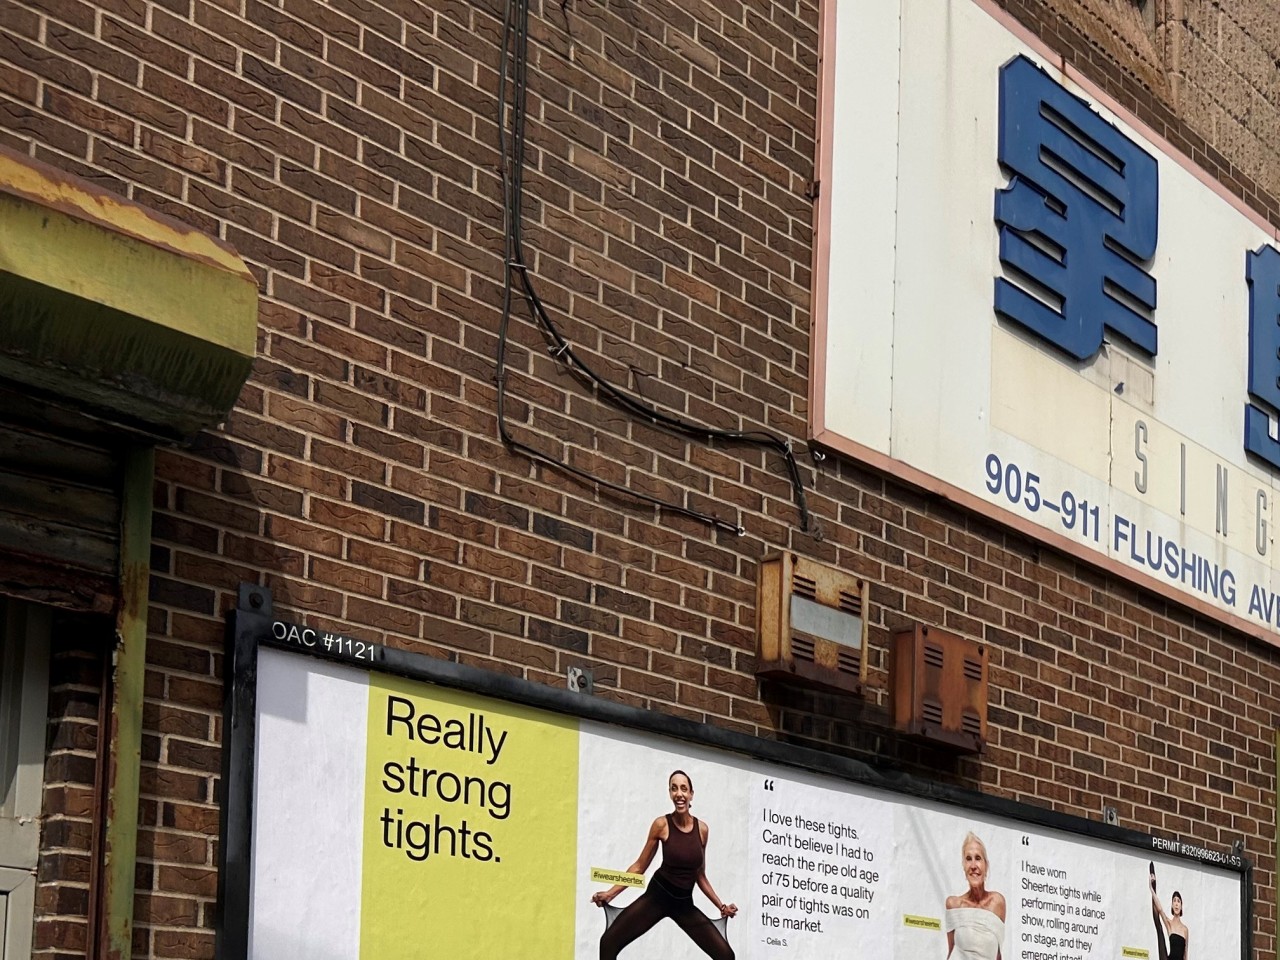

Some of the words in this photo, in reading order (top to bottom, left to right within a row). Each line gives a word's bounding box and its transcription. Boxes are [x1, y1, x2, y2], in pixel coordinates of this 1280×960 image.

[1134, 419, 1268, 556] SING
[985, 453, 1100, 543] 905-911
[1113, 514, 1236, 607] FLUSHING
[272, 621, 316, 647] OAC
[323, 633, 376, 662] #1121
[385, 695, 508, 765] Really
[382, 757, 512, 820] strong
[380, 807, 502, 863] tights.
[763, 808, 766, 822] I
[769, 809, 792, 826] love
[795, 815, 825, 833] these
[828, 822, 859, 839] tights.
[763, 829, 792, 847] Can't
[795, 835, 833, 854] believe
[841, 844, 860, 860] had
[863, 849, 873, 861] to
[1152, 837, 1180, 853] PERMIT
[762, 852, 794, 868] reach
[798, 857, 815, 871] the
[818, 860, 838, 876] ripe
[841, 865, 856, 878] old
[859, 870, 879, 883] age
[1026, 861, 1045, 876] have
[1047, 868, 1066, 879] worn
[762, 872, 773, 884] of
[776, 873, 789, 887] 75
[793, 876, 828, 893] before
[831, 885, 837, 894] a
[840, 886, 874, 903] quality
[1022, 878, 1058, 895] Sheertex
[1059, 885, 1080, 903] tights
[1082, 891, 1101, 902] while
[762, 894, 783, 907] pair
[786, 896, 797, 908] of
[800, 897, 829, 914] tights
[832, 905, 853, 917] was
[856, 909, 869, 919] on
[1022, 897, 1065, 915] performing
[1067, 902, 1073, 914] in
[1075, 907, 1080, 915] a
[1082, 905, 1105, 920] dance
[762, 913, 779, 927] the
[783, 917, 823, 933] market.
[1022, 914, 1045, 928] show,
[1046, 918, 1069, 933] rolling
[1072, 924, 1098, 935] around
[1022, 932, 1032, 942] on
[1034, 934, 1058, 948] stage,
[1060, 937, 1074, 949] and
[1076, 939, 1092, 953] they
